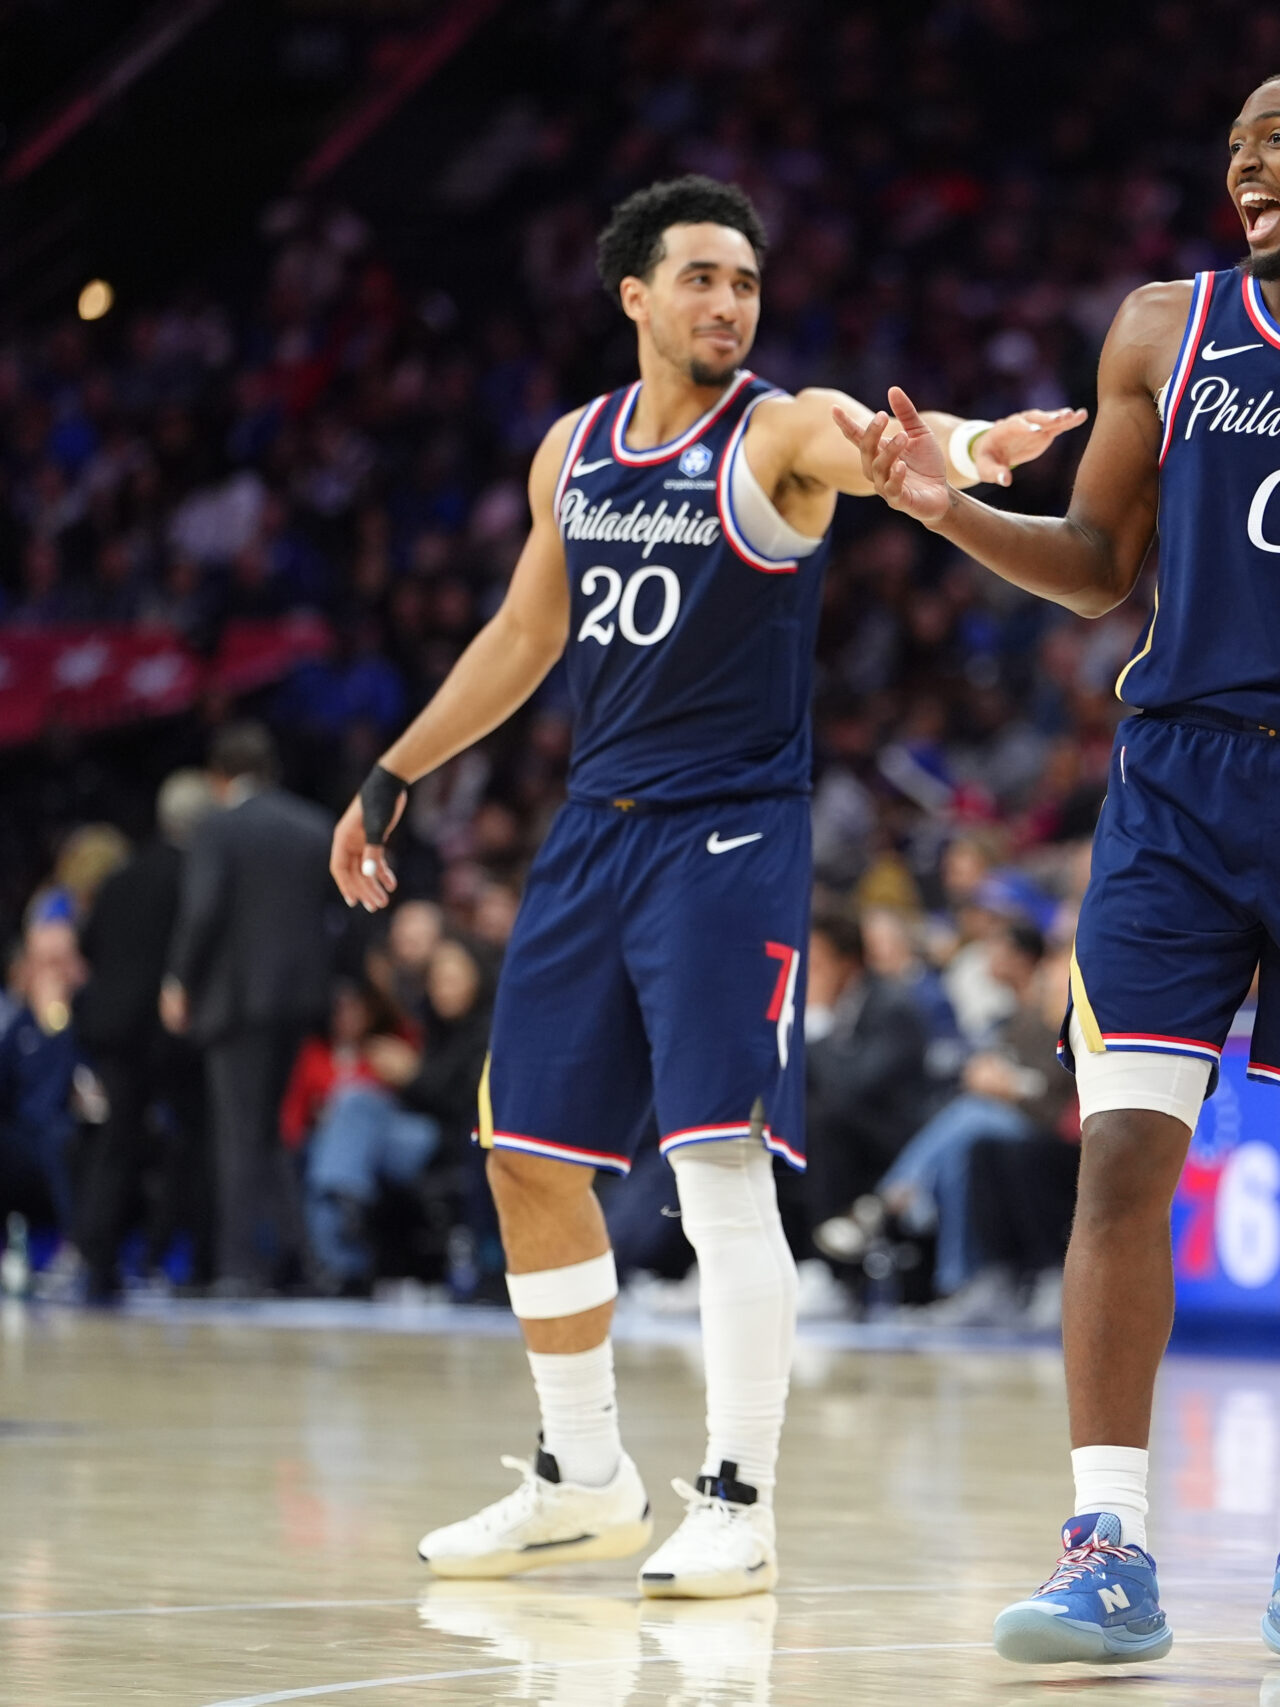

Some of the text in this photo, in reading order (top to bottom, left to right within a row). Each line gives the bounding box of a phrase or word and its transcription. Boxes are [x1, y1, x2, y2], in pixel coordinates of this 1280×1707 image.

[663, 479, 716, 491] crypto.com
[559, 488, 721, 559] Philadelphia
[577, 564, 681, 646] 20
[1097, 1584, 1130, 1614] N
